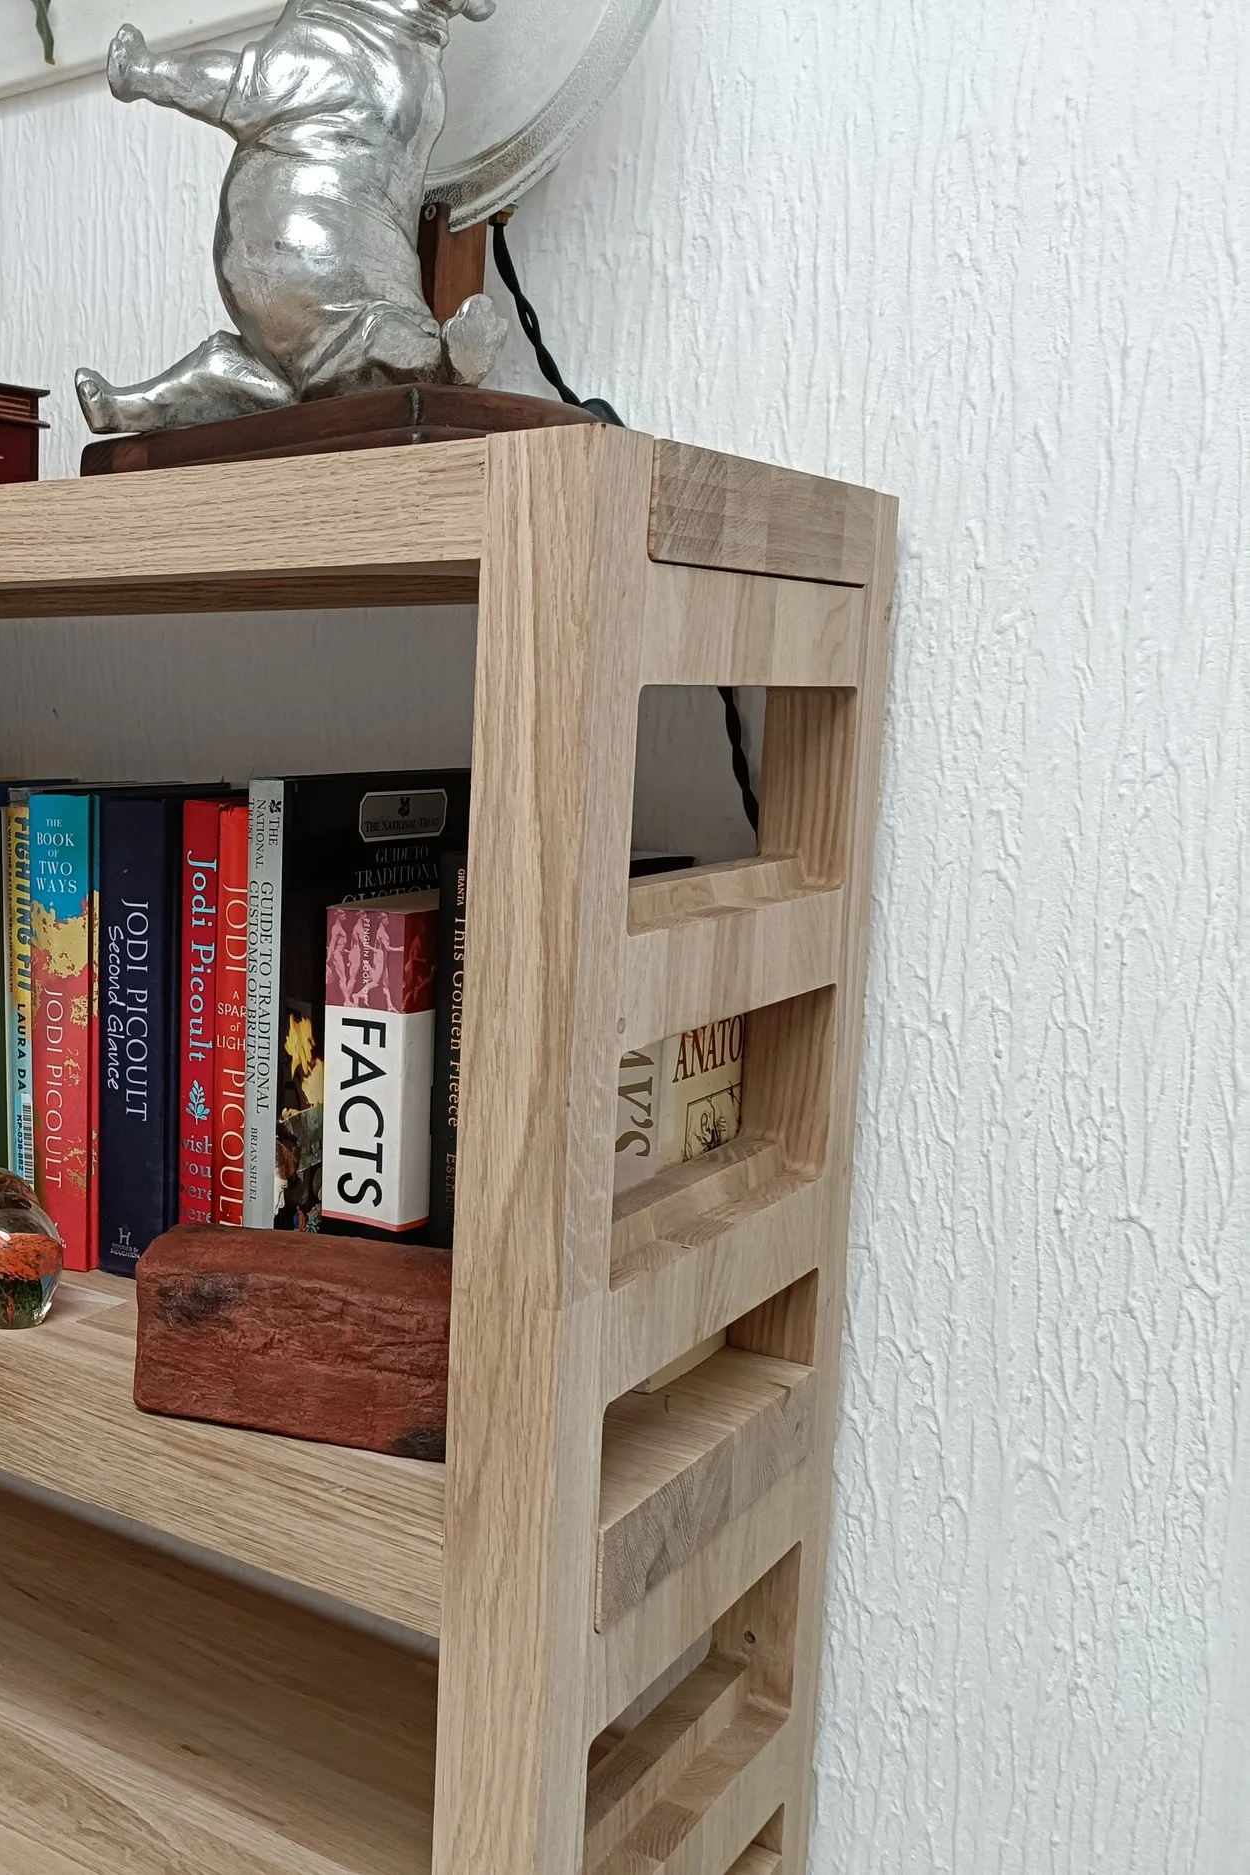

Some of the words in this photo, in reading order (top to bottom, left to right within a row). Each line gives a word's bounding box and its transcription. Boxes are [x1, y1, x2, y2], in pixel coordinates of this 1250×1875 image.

[36, 832, 76, 847] BOOK
[45, 818, 63, 828] THE
[255, 799, 266, 869] NATIONAL
[268, 816, 281, 846] THE
[381, 818, 416, 831] NATIONAL
[38, 860, 73, 876] TWO
[47, 849, 60, 858] OF
[375, 847, 410, 864] GUIDE
[414, 845, 429, 860] TO
[14, 816, 31, 945] FIGHTING
[36, 877, 77, 894] WAYS
[186, 850, 217, 928] Jodi
[456, 868, 466, 906] GRANTA
[223, 883, 248, 972] JODI
[248, 880, 259, 974] CUSTOMS
[260, 881, 273, 944] GUIDE
[121, 898, 148, 973] JODI
[363, 918, 371, 957] PENGUIN
[17, 953, 31, 991] FIT
[107, 925, 126, 1006] Second
[259, 948, 273, 976] TO
[188, 940, 216, 1062] Picoult
[232, 991, 239, 1000] A
[247, 978, 257, 1005] OF
[17, 1003, 27, 1060] LAURA
[45, 988, 64, 1052] JODI
[230, 1022, 241, 1032] of
[106, 1013, 125, 1091] Glance
[125, 987, 148, 1122] PICOULT
[246, 1009, 257, 1086] BRITAIN
[256, 981, 272, 1114] TRADITIONAL
[17, 1068, 27, 1094] DA
[45, 1064, 63, 1188] PICOULT
[337, 1018, 388, 1207] FACTS
[249, 1127, 258, 1163] BRIAN
[249, 1164, 257, 1202] SHUEL
